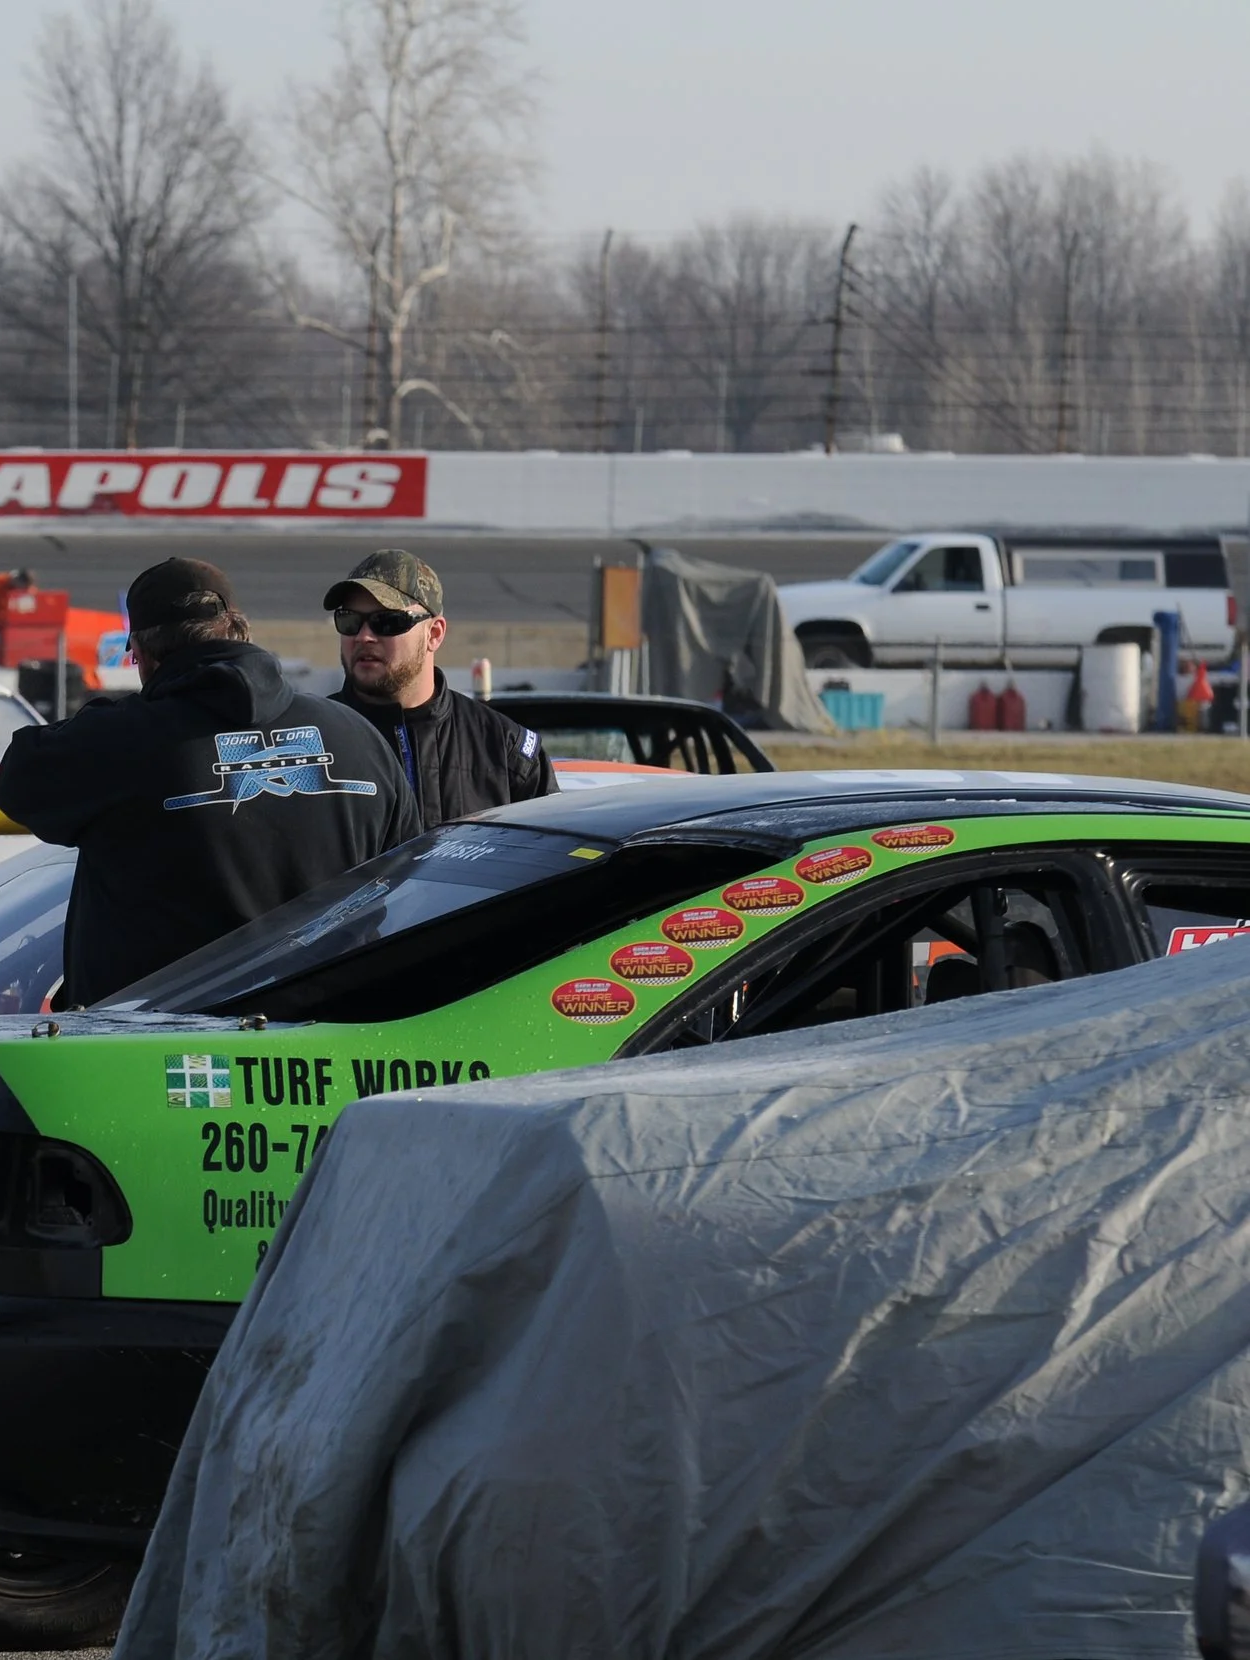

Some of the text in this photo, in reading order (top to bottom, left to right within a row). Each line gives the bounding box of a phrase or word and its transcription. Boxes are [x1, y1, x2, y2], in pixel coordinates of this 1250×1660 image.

[220, 729, 315, 746] JOHN LONG
[220, 755, 331, 772] RACING
[807, 855, 870, 881] WINNER
[726, 888, 782, 899] FEATURE
[732, 893, 799, 908] WINNER
[666, 919, 722, 930] FEATURE
[672, 925, 739, 940] WINNER
[1181, 932, 1248, 950] LA
[615, 955, 671, 965] FEATURE
[620, 963, 688, 976] WINNER
[557, 993, 613, 1002] FEATURE
[561, 1001, 629, 1013] WINNER
[235, 1056, 333, 1106] TURF
